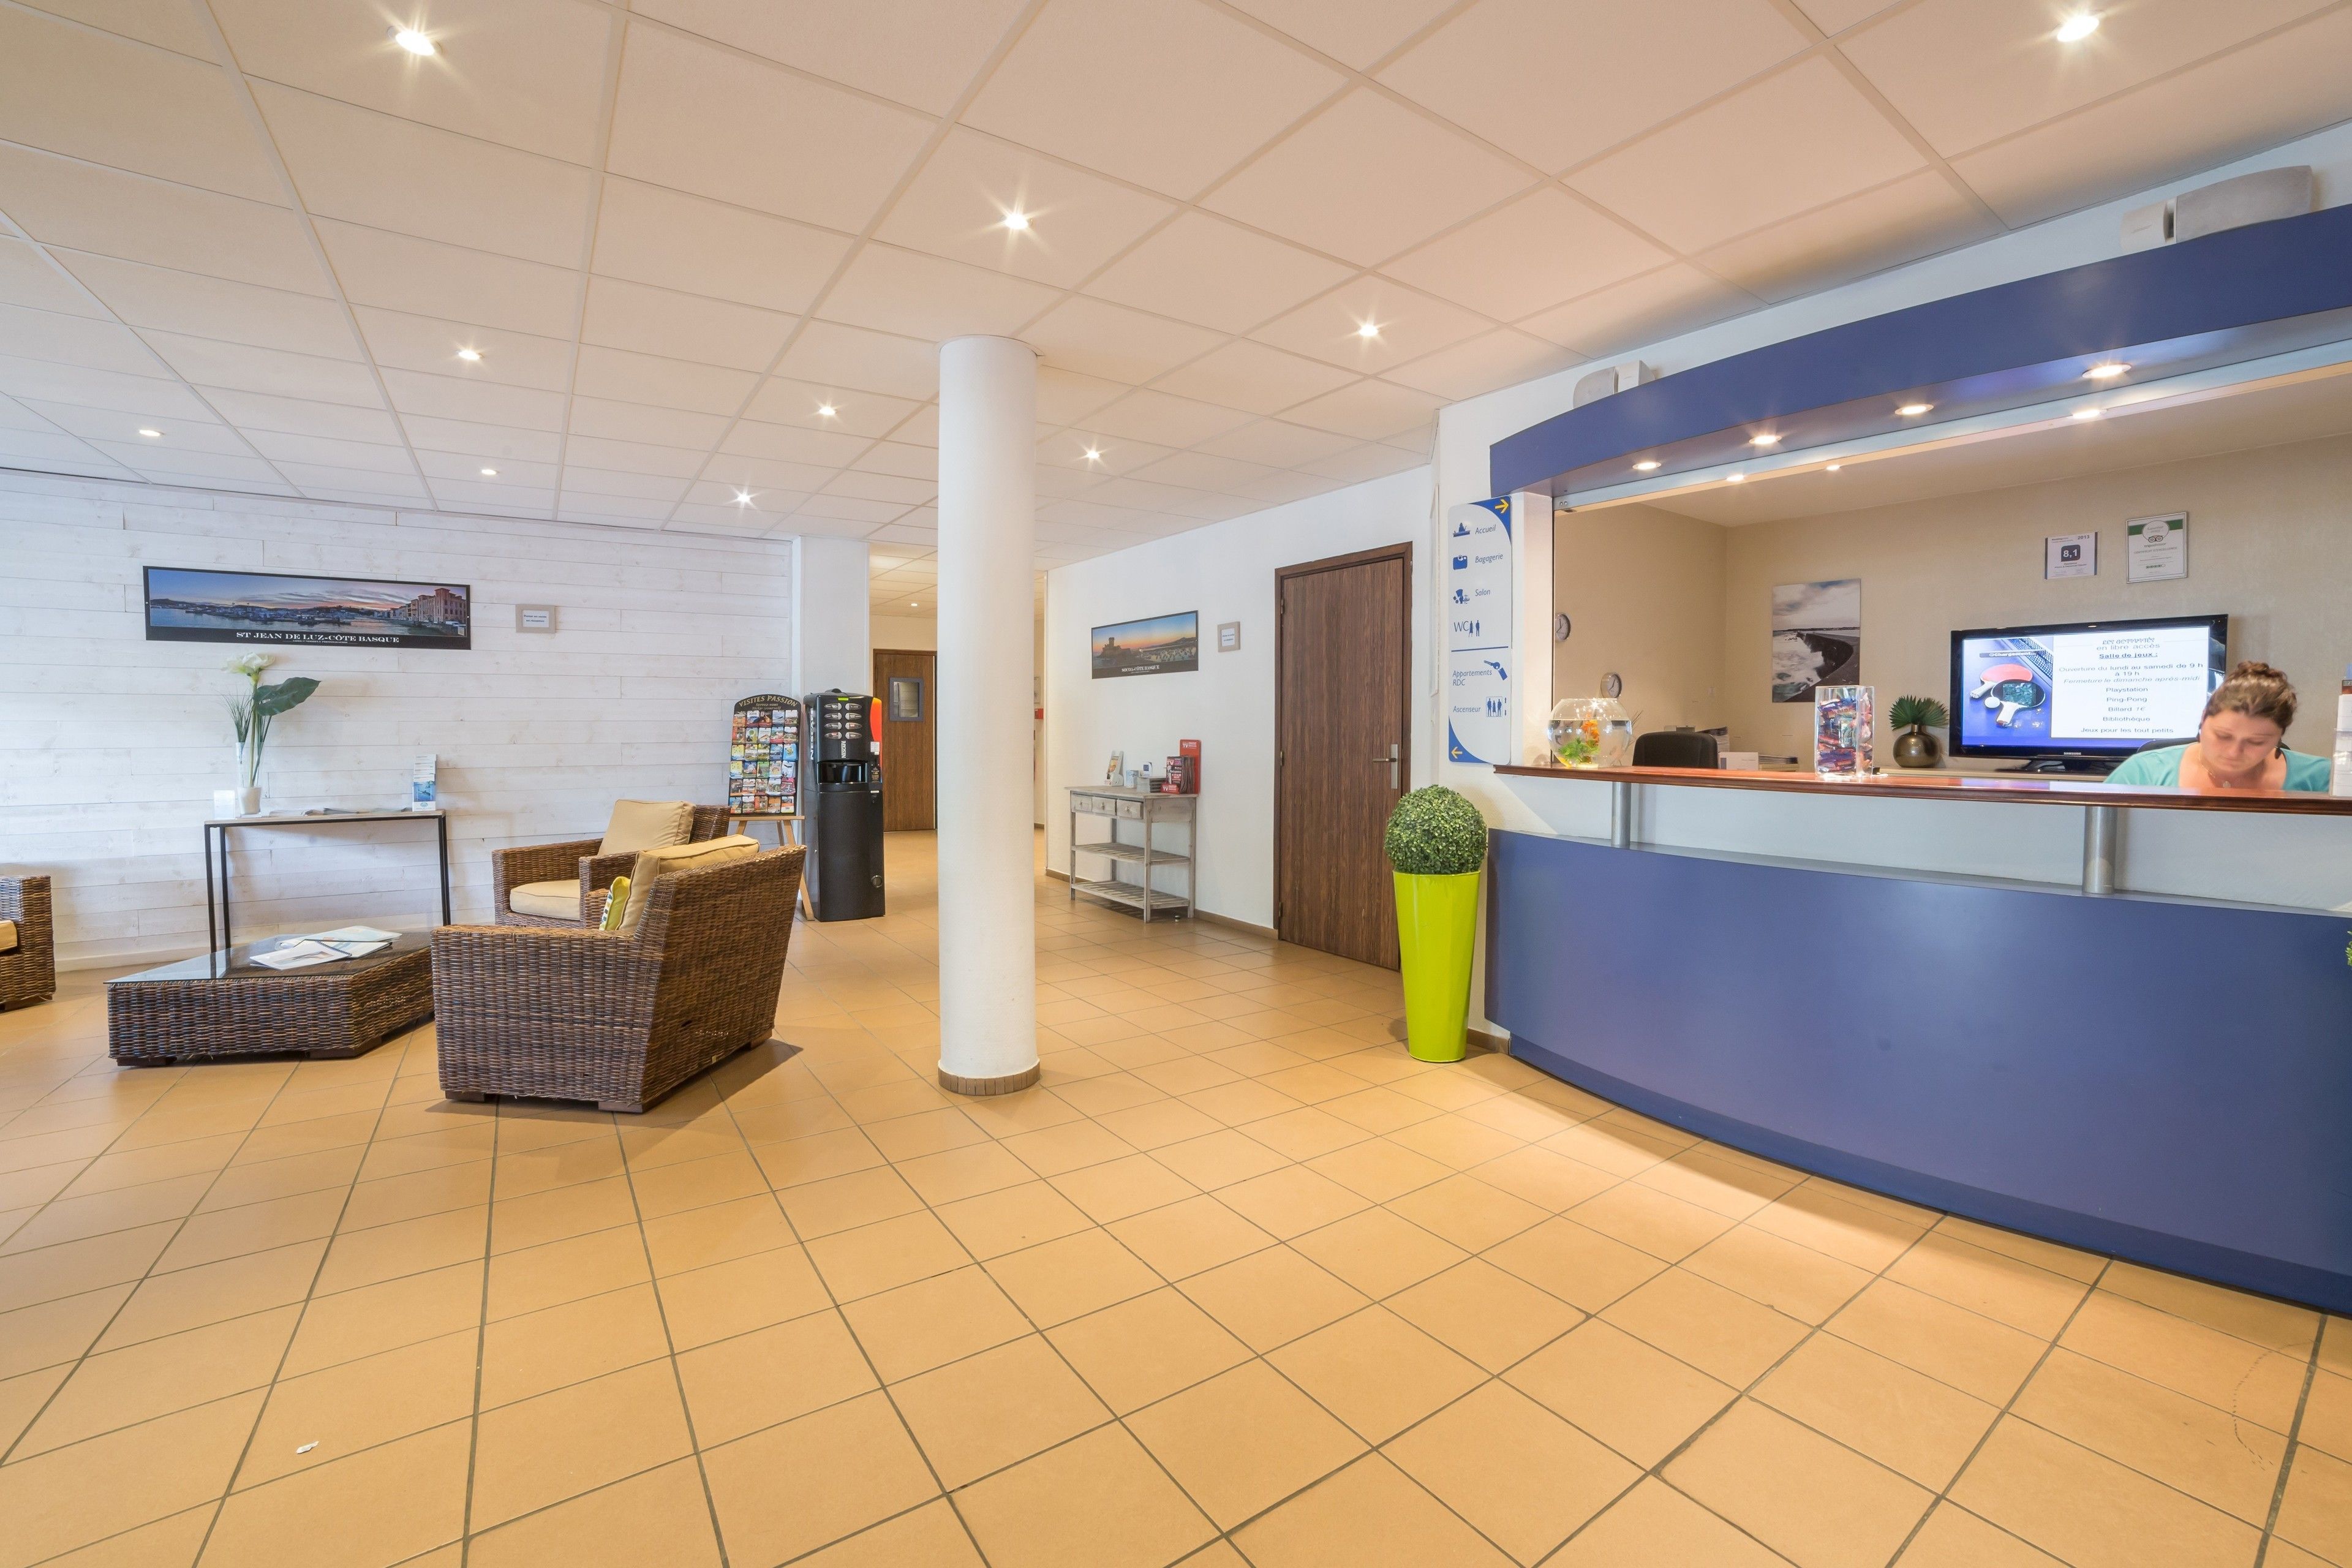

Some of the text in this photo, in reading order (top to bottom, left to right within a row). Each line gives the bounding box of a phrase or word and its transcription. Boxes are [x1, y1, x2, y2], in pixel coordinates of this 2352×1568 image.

[1475, 524, 1496, 534] Accueil
[1475, 553, 1503, 564] Bagagerie
[2064, 549, 2077, 558] 8,1
[1453, 620, 1469, 632] WC
[1452, 669, 1492, 679] Appartements
[739, 695, 797, 707] VISITES PASSION
